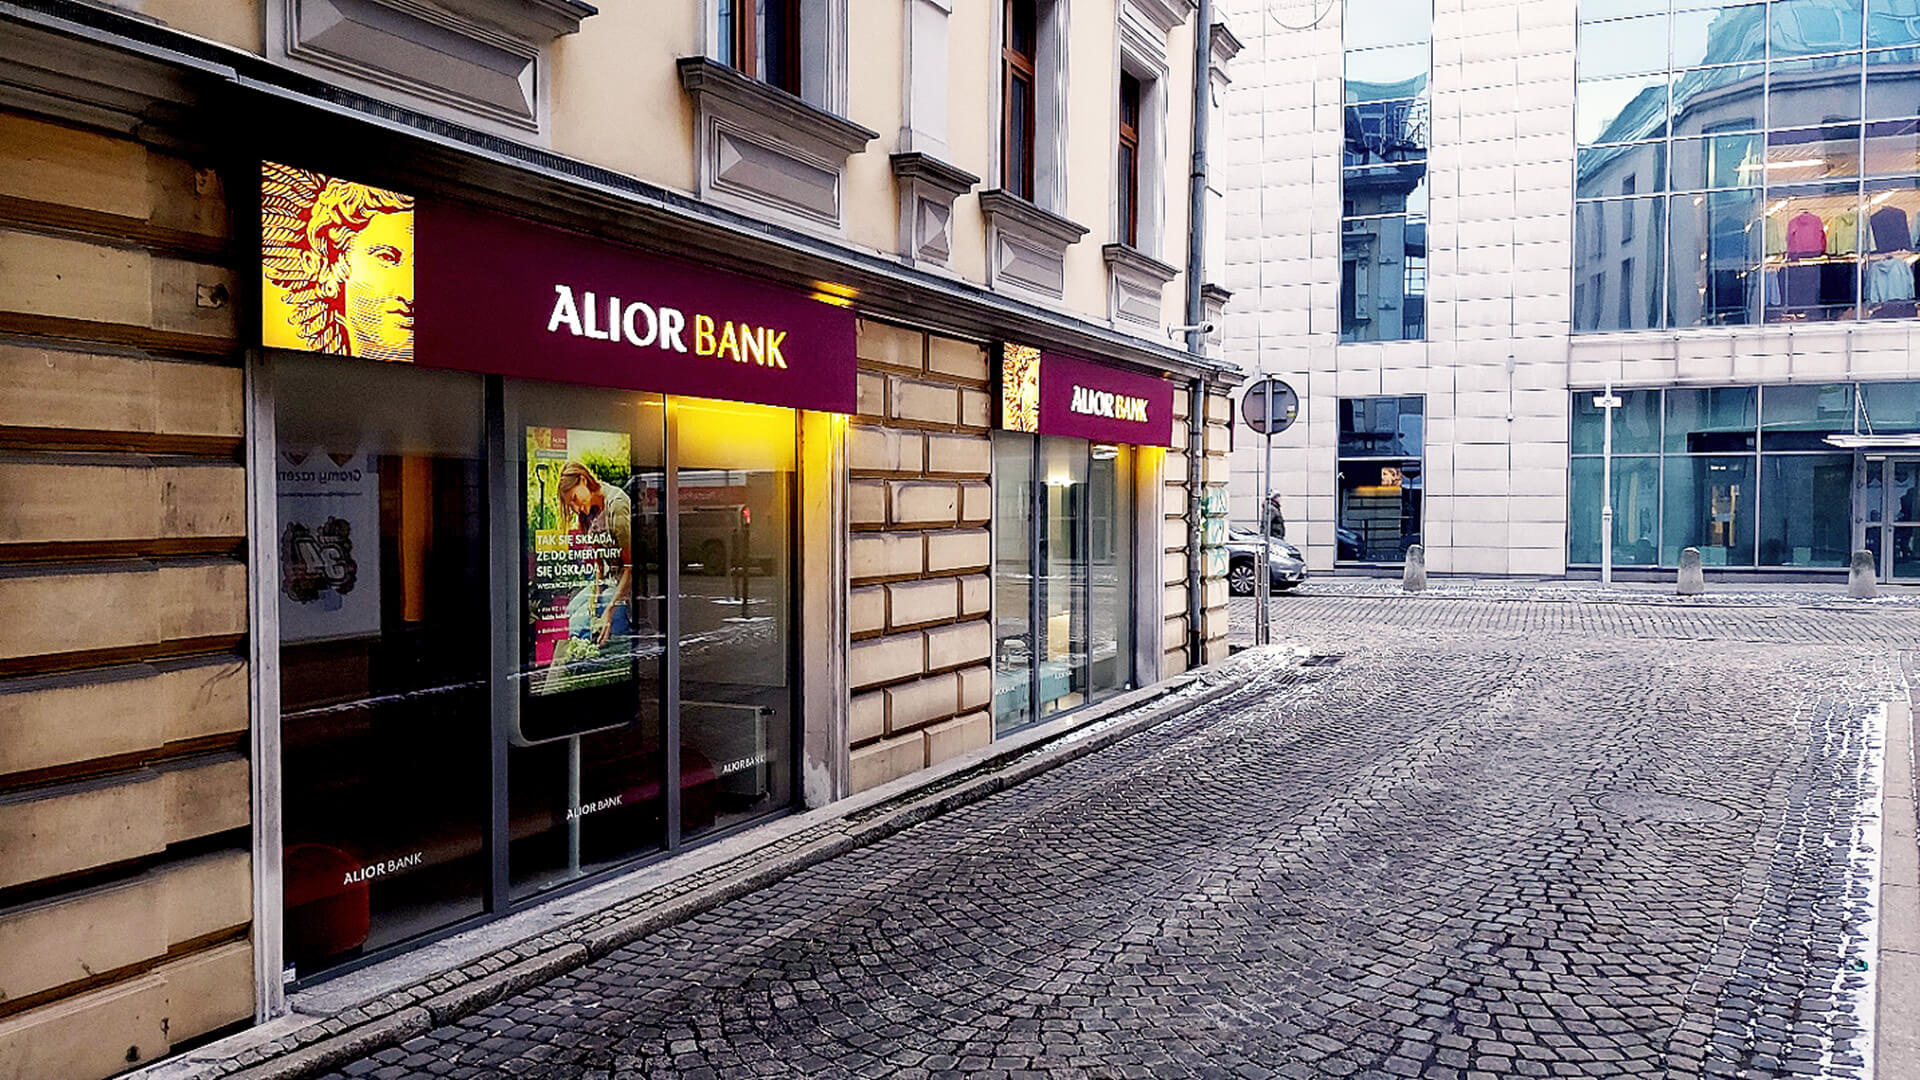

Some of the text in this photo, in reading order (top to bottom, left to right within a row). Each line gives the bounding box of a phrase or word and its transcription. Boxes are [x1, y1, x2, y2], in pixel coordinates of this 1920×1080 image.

[547, 284, 788, 369] ALIOR BANK
[1070, 384, 1148, 422] ALIOR BANK
[537, 534, 557, 546] TAK
[559, 534, 574, 547] SIĘ
[568, 547, 622, 561] EMERYTURY
[536, 564, 553, 579] SIĘ
[566, 794, 623, 820] ALIOR BANK
[343, 852, 422, 886] ALIOR BANK
